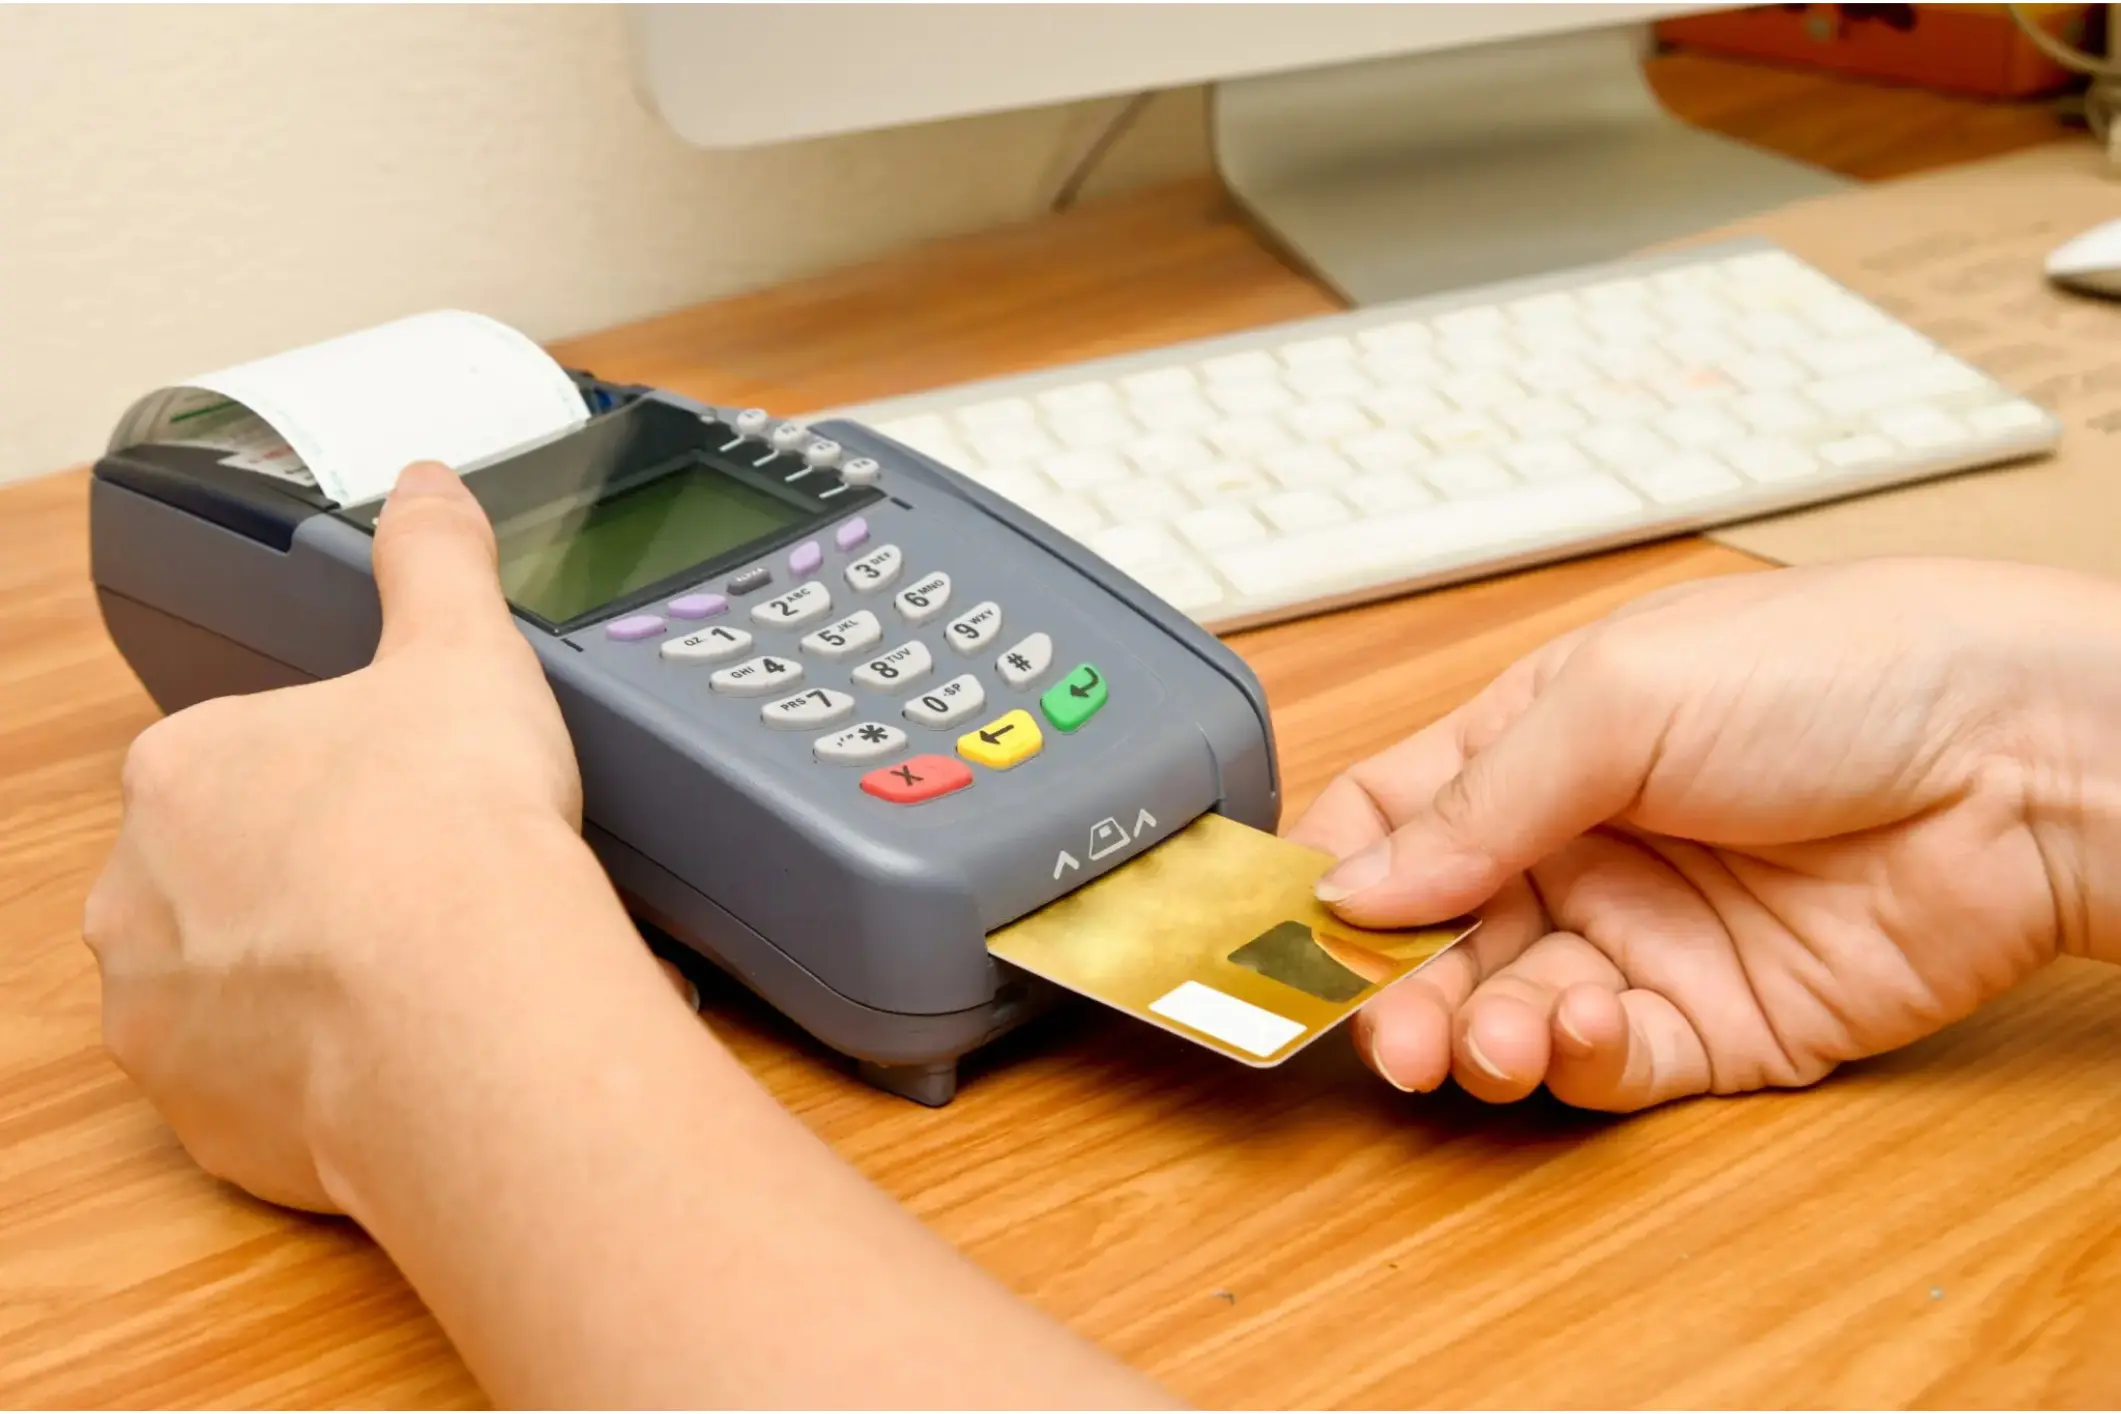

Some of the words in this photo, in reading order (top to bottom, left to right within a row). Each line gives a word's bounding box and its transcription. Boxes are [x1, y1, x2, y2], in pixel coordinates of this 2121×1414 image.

[854, 563, 881, 579] 3
[870, 552, 892, 565] DEF
[770, 600, 799, 617] 2
[788, 588, 811, 603] ABC
[904, 592, 929, 608] 6
[917, 579, 945, 596] MNO
[711, 628, 736, 642] 1
[817, 629, 846, 647] 5
[837, 619, 860, 633] JKL
[953, 623, 980, 640] 9
[969, 608, 995, 625] WXY
[731, 666, 755, 679] GHI
[763, 658, 786, 674] 4
[870, 661, 899, 679] 8
[885, 648, 911, 664] TUV
[780, 697, 807, 712] PRS
[806, 690, 832, 708] 7
[922, 696, 949, 713] 0
